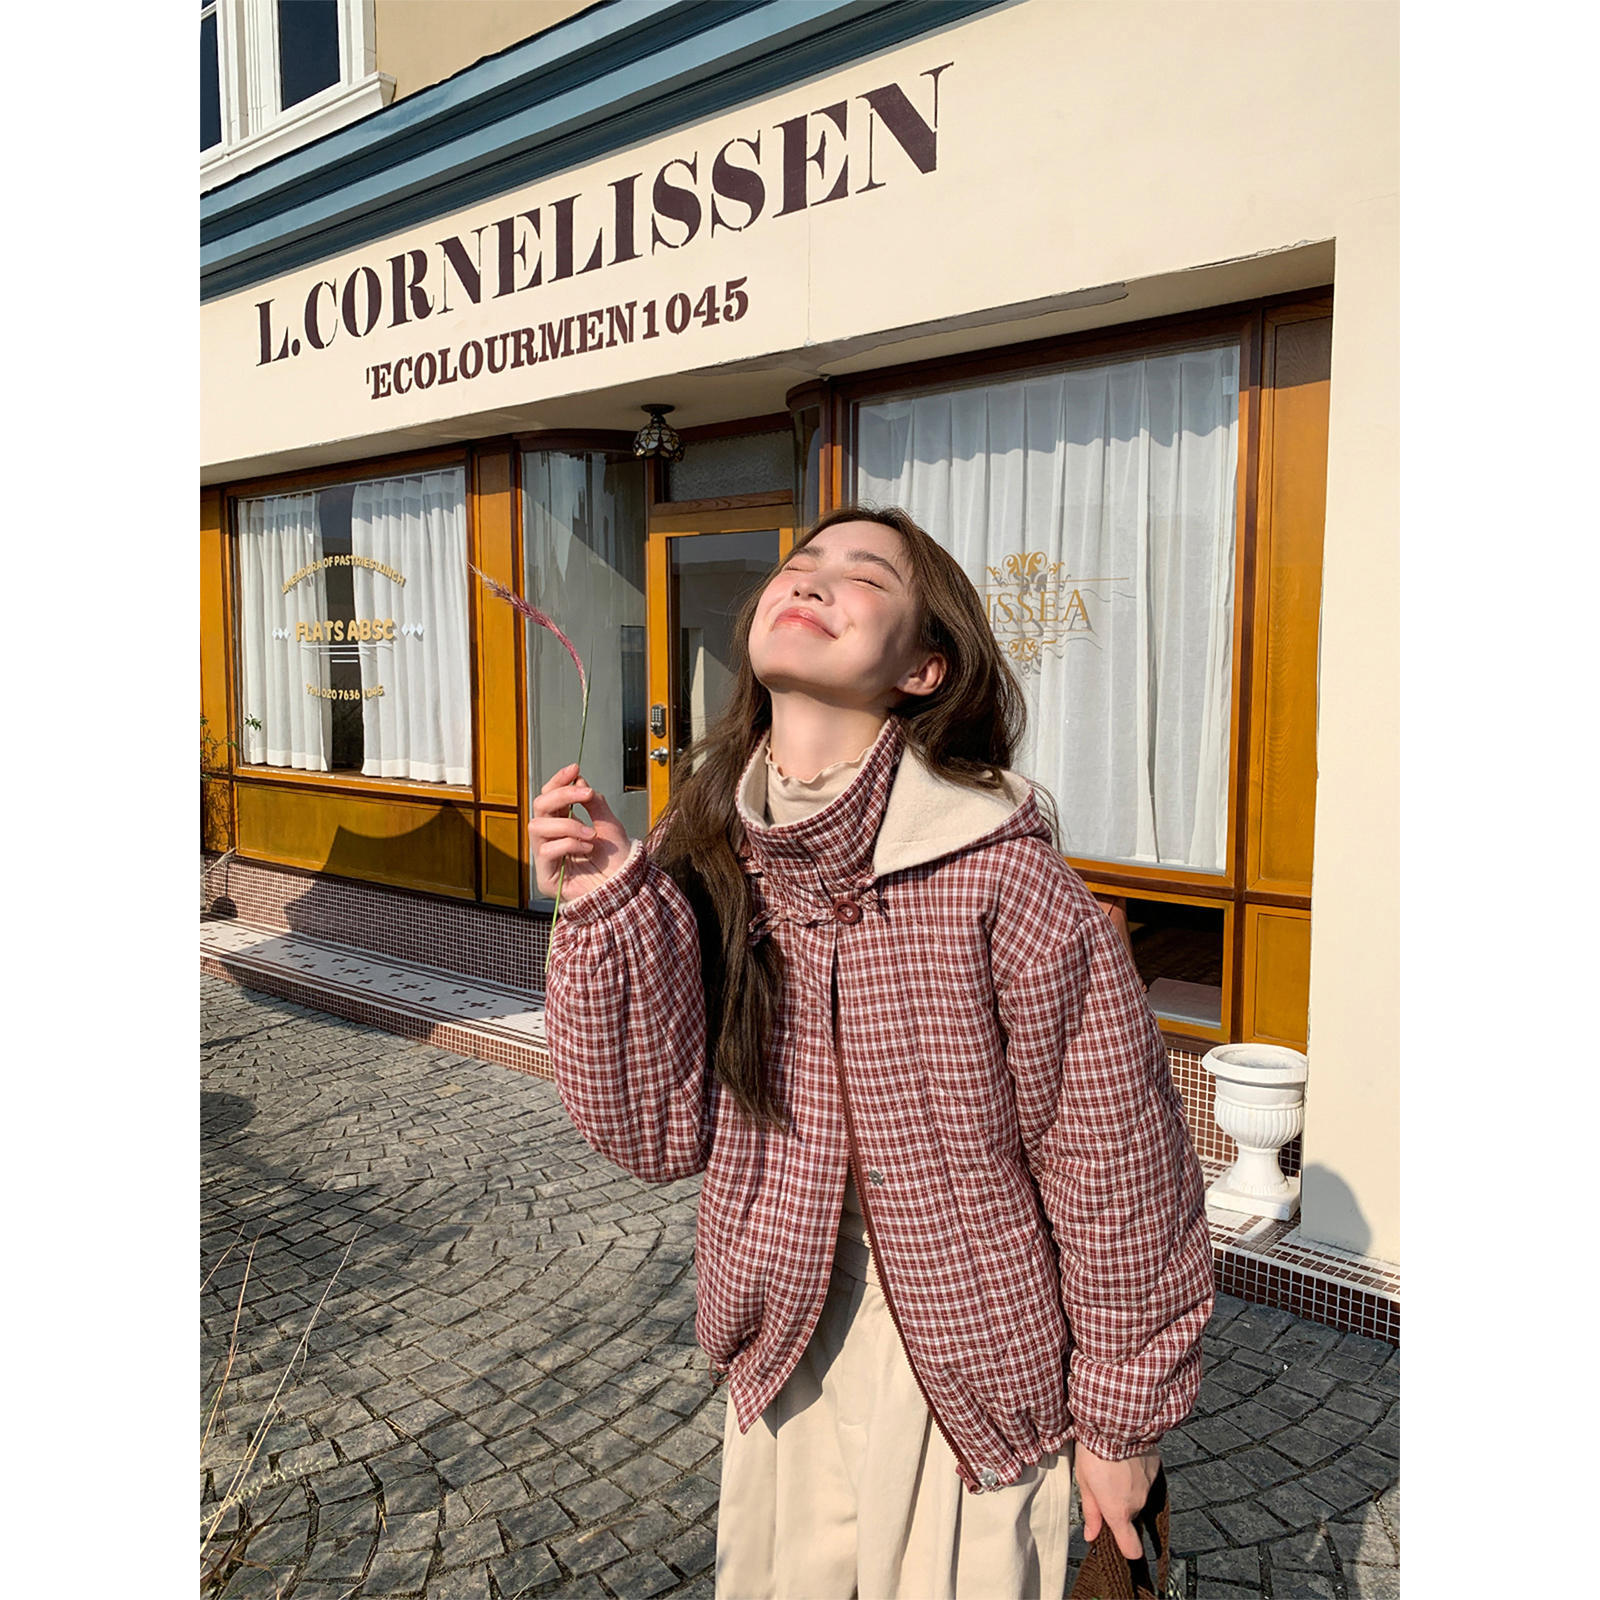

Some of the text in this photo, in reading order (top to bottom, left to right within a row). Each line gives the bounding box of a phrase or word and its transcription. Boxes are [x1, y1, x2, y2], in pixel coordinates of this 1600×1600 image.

[323, 556, 334, 568] OF
[296, 618, 395, 642] FLATS ABSC
[338, 690, 360, 700] 7636
